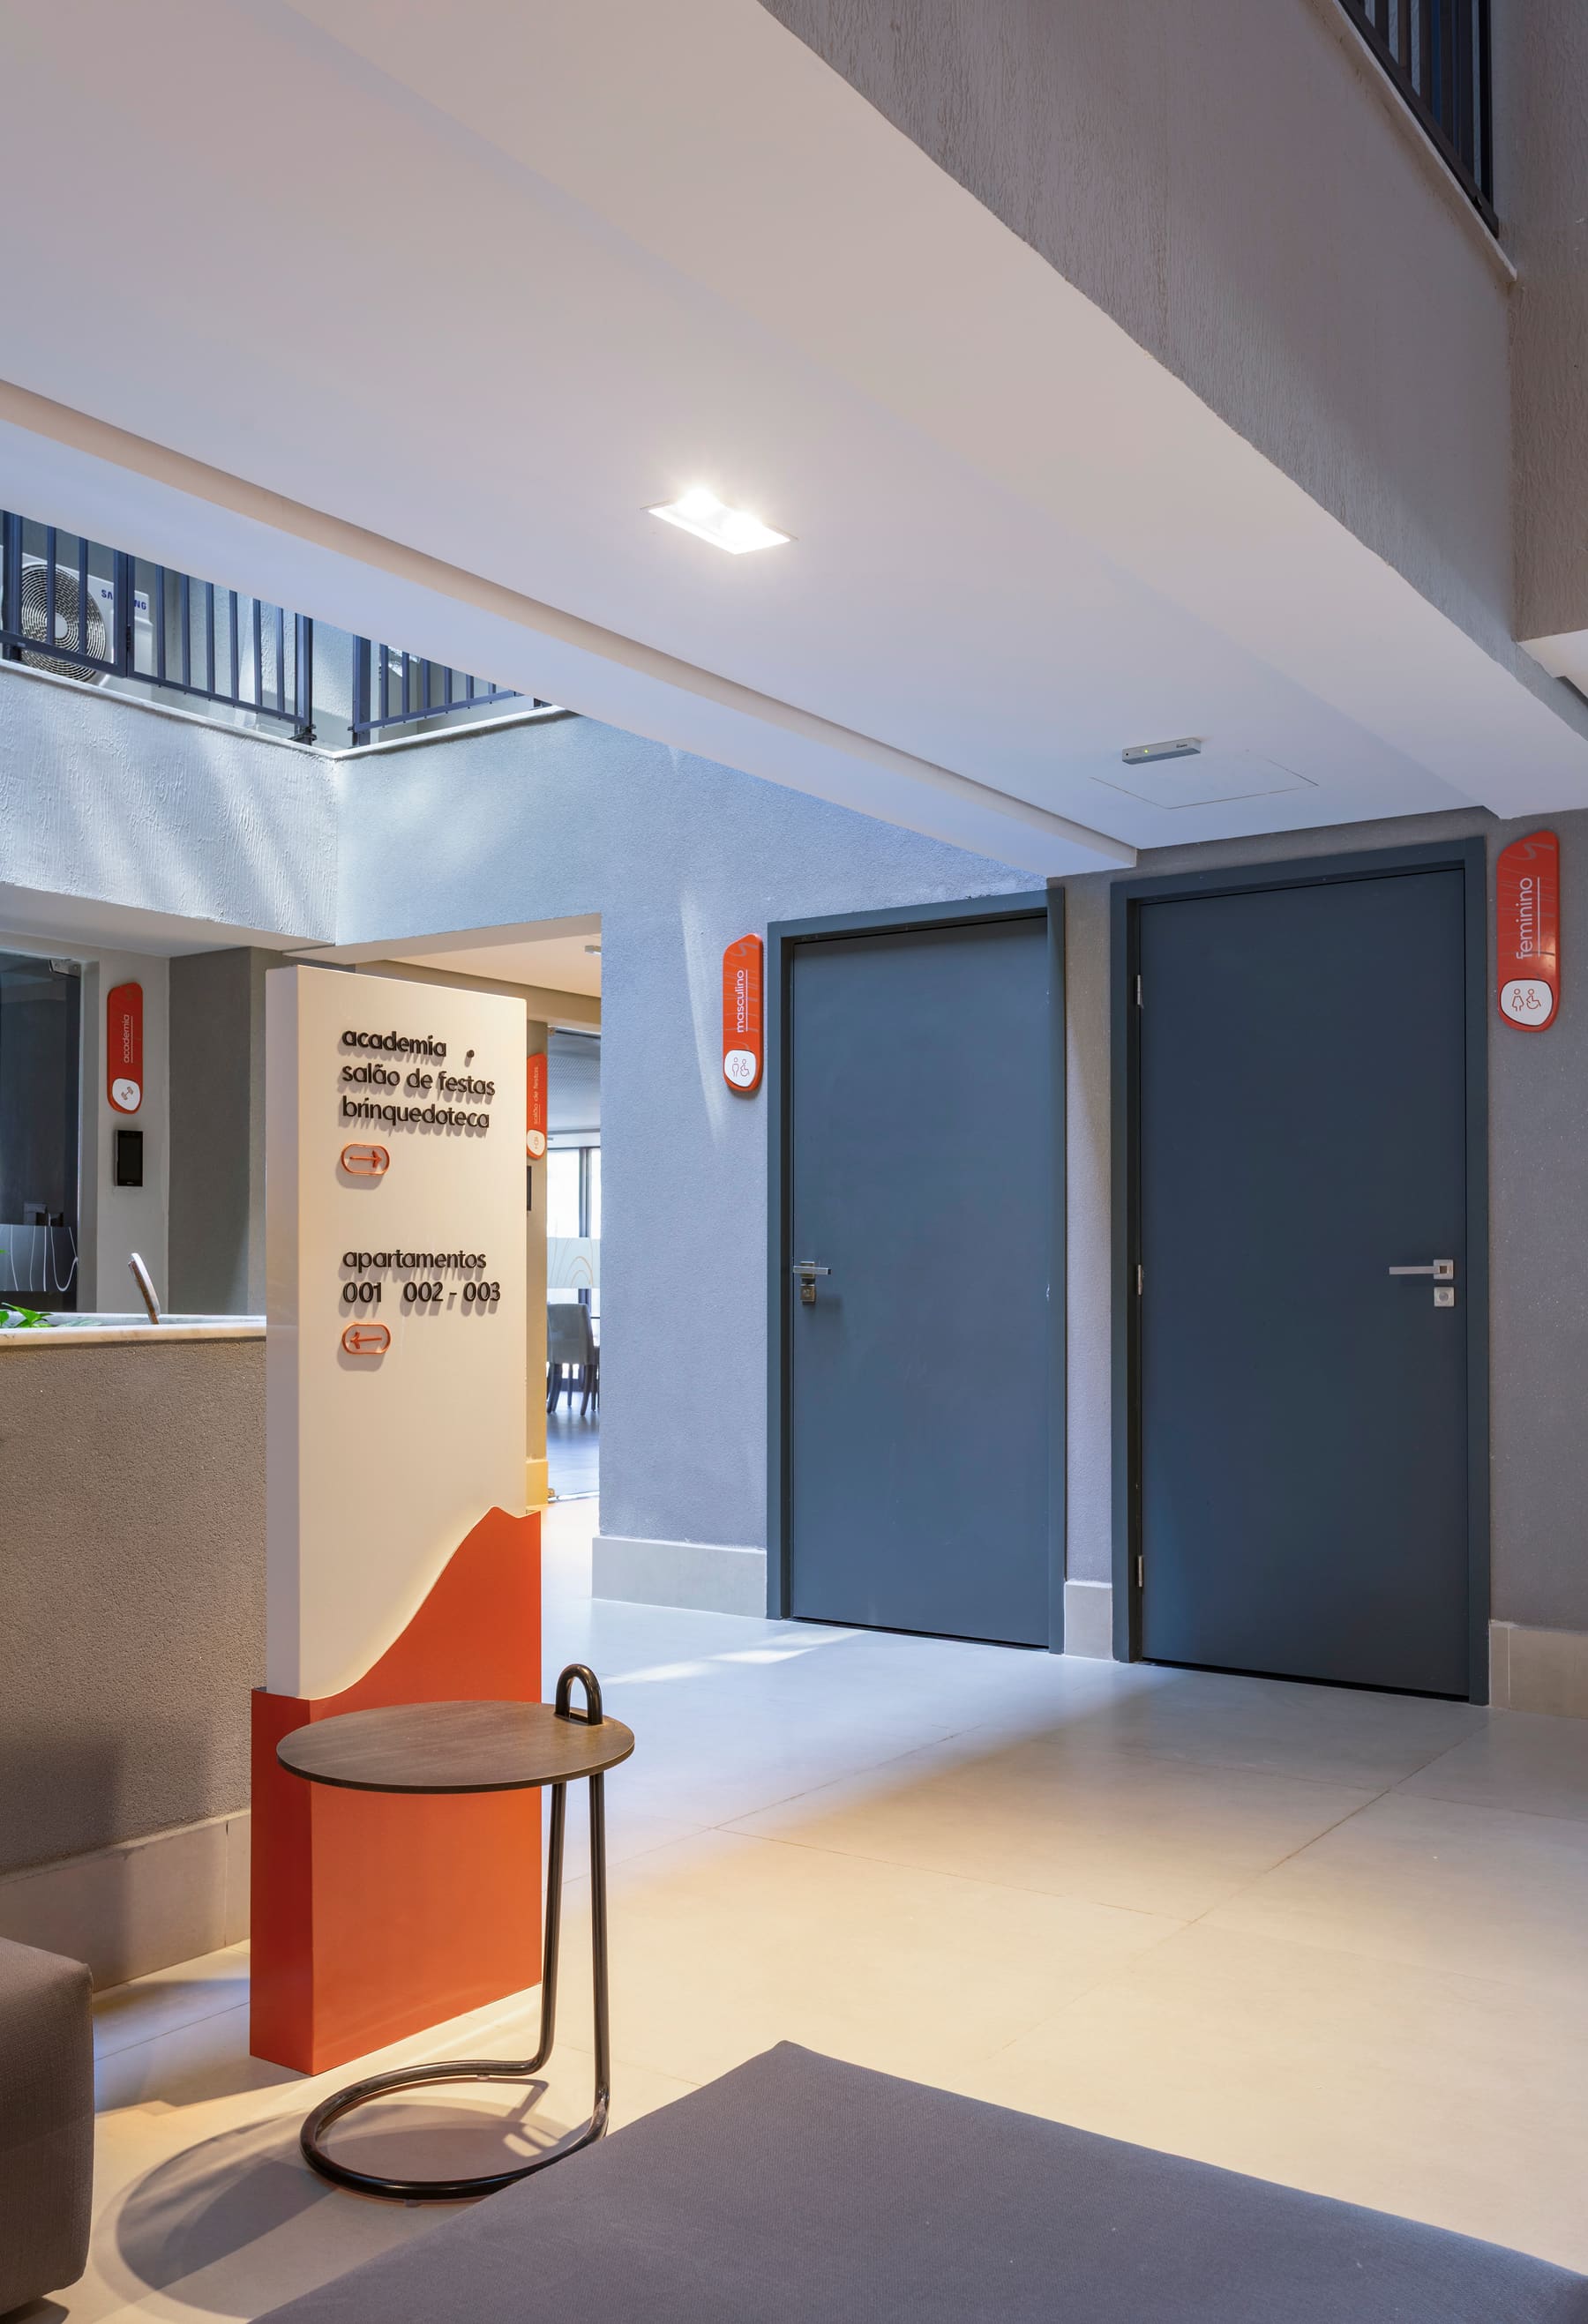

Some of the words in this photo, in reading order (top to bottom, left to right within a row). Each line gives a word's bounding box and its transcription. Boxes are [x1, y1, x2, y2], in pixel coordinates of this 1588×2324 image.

[101, 589, 147, 610] SANG
[1516, 877, 1532, 960] feminino
[341, 1030, 446, 1057] academia
[341, 1063, 401, 1087] salão
[406, 1068, 433, 1089] de
[438, 1071, 496, 1095] festas
[342, 1095, 490, 1129] brinquedoteca
[342, 1249, 487, 1274] apartamentos
[342, 1282, 382, 1303] 001
[403, 1282, 444, 1302] 002
[463, 1282, 500, 1302] 003
